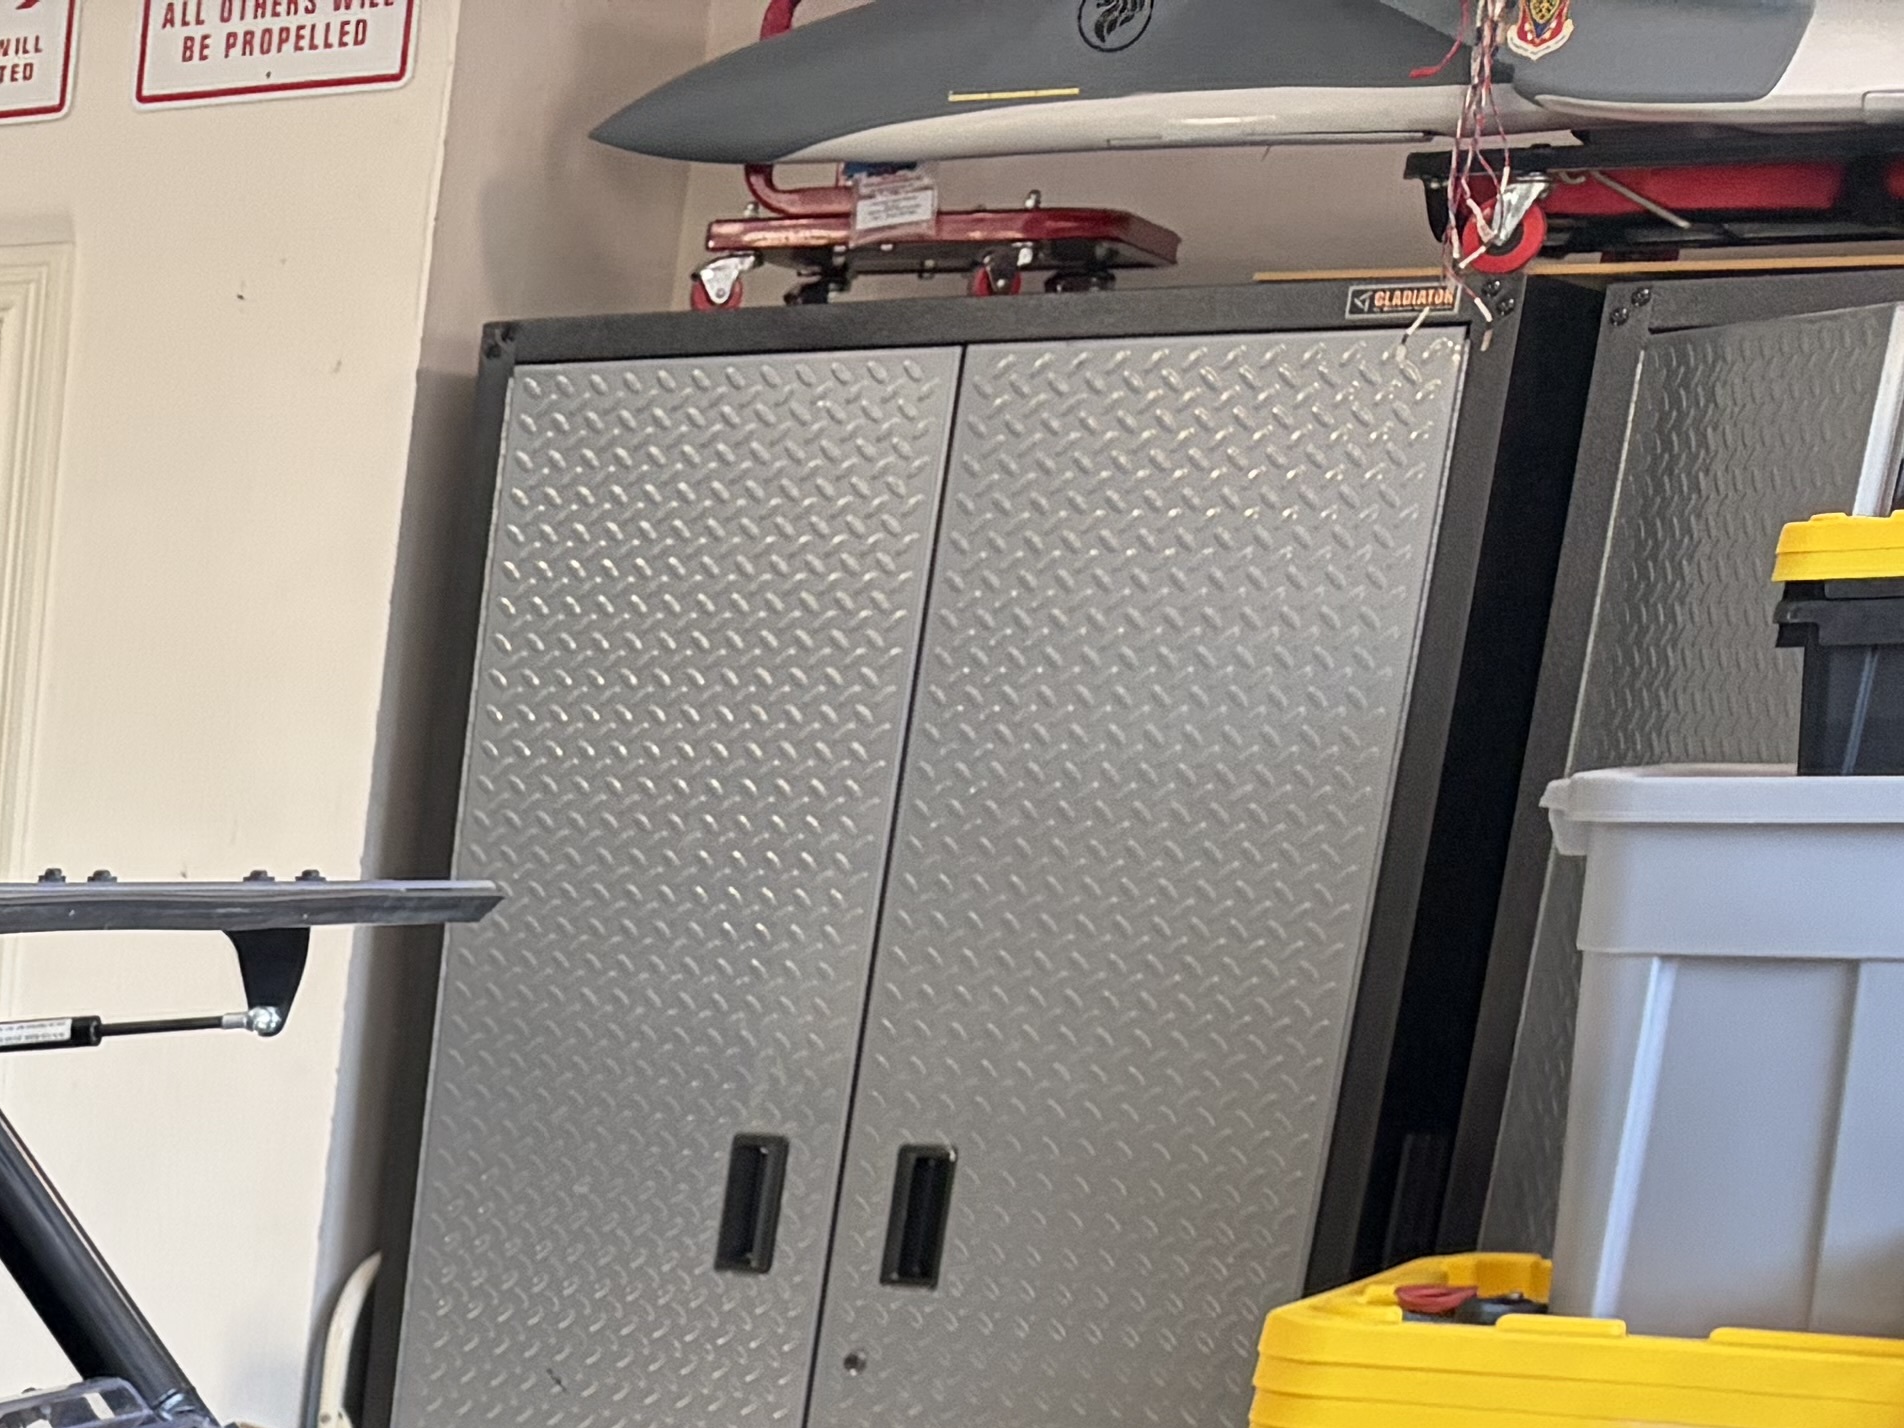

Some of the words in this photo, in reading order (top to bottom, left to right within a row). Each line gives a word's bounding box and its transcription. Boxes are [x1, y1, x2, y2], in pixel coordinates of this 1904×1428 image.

[162, 0, 206, 29] ALL
[182, 34, 212, 62] BE
[224, 19, 368, 59] PROPELLED
